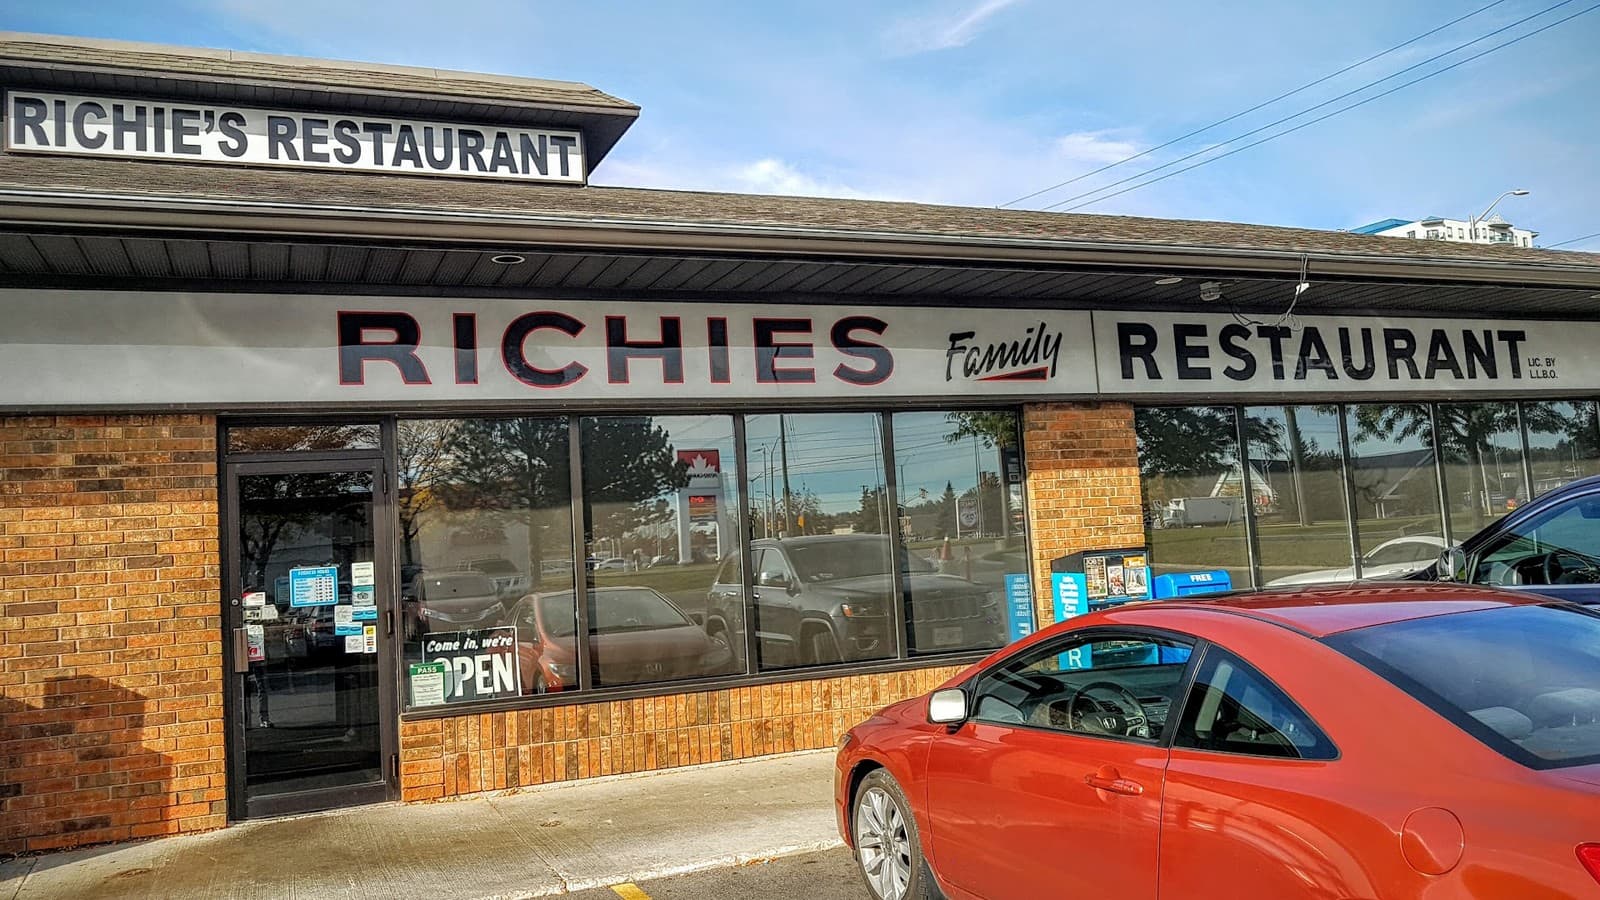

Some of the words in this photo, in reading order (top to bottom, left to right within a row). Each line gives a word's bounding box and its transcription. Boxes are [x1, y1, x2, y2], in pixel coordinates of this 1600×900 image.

[13, 96, 248, 158] RICHIE'S
[267, 114, 578, 177] RESTAURANT
[337, 310, 893, 387] RICHIES
[946, 321, 1063, 382] Family
[1117, 322, 1526, 380] RESTAURANT
[1528, 357, 1543, 367] LIC.
[1545, 357, 1556, 367] BY
[1190, 573, 1213, 583] FREE
[427, 640, 460, 653] Come
[463, 638, 479, 650] in,
[482, 636, 513, 648] we're
[417, 666, 437, 674] PASS
[433, 652, 514, 698] OPEN
